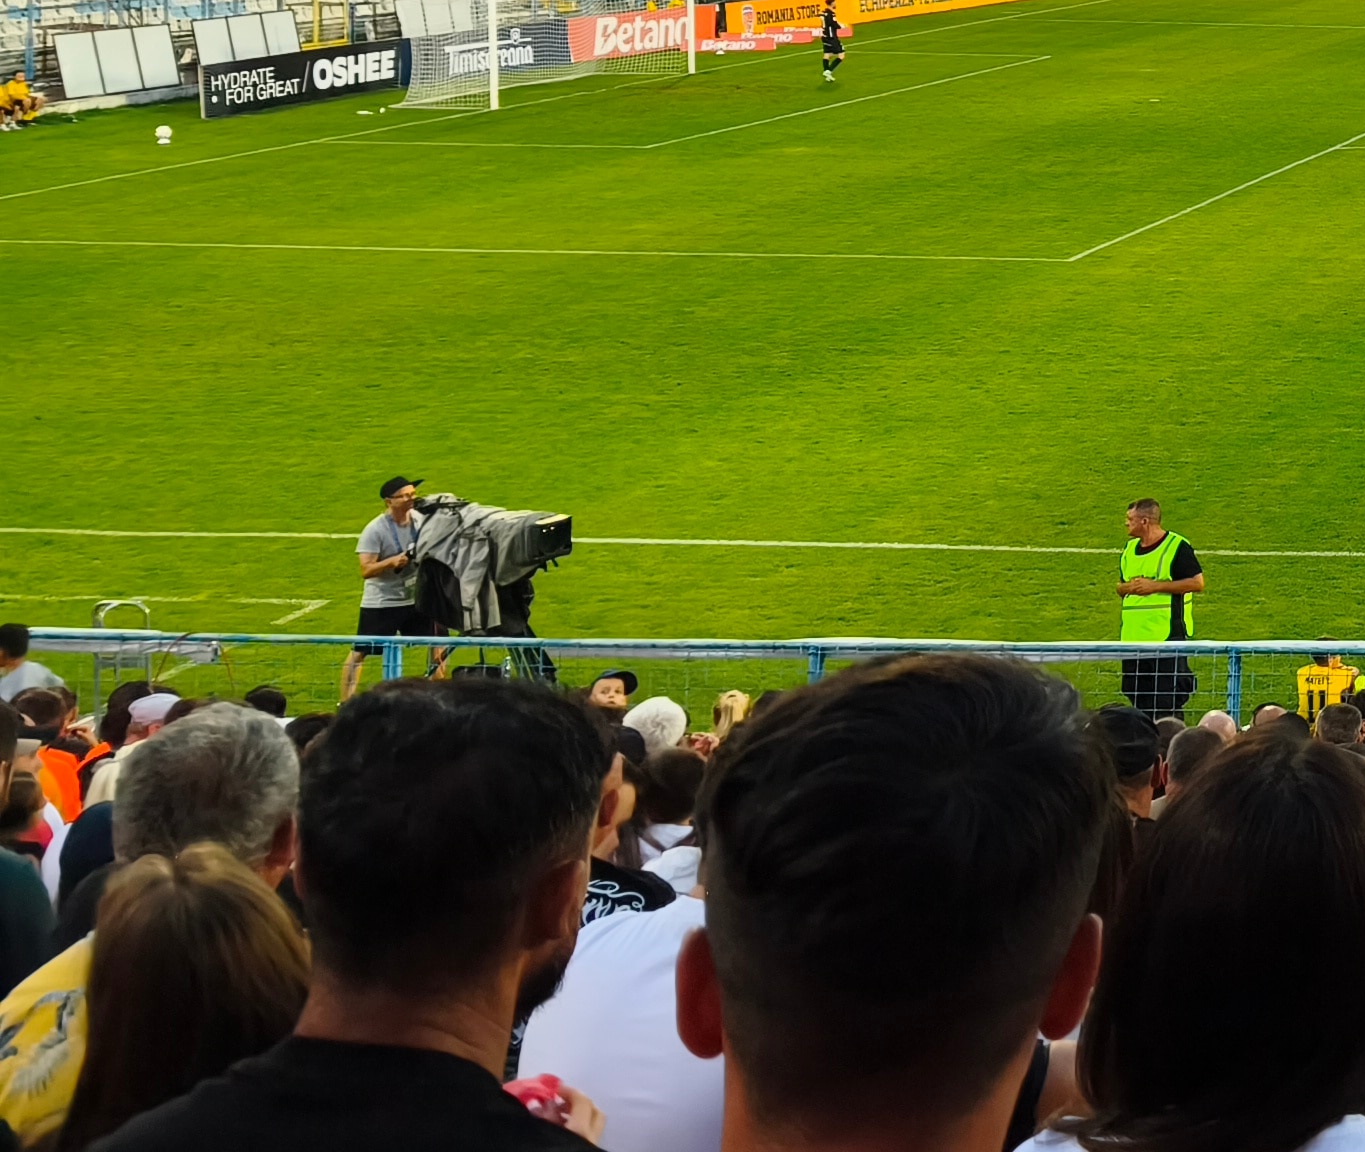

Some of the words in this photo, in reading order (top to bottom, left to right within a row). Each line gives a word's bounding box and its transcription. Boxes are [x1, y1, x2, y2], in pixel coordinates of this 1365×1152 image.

[756, 7, 795, 26] ROMANIA
[796, 4, 821, 20] STORE
[700, 39, 756, 51] Betano
[211, 66, 275, 92] HYDRATE
[312, 49, 396, 90] OSHEE
[225, 86, 254, 106] FOR
[256, 78, 301, 101] GREAT
